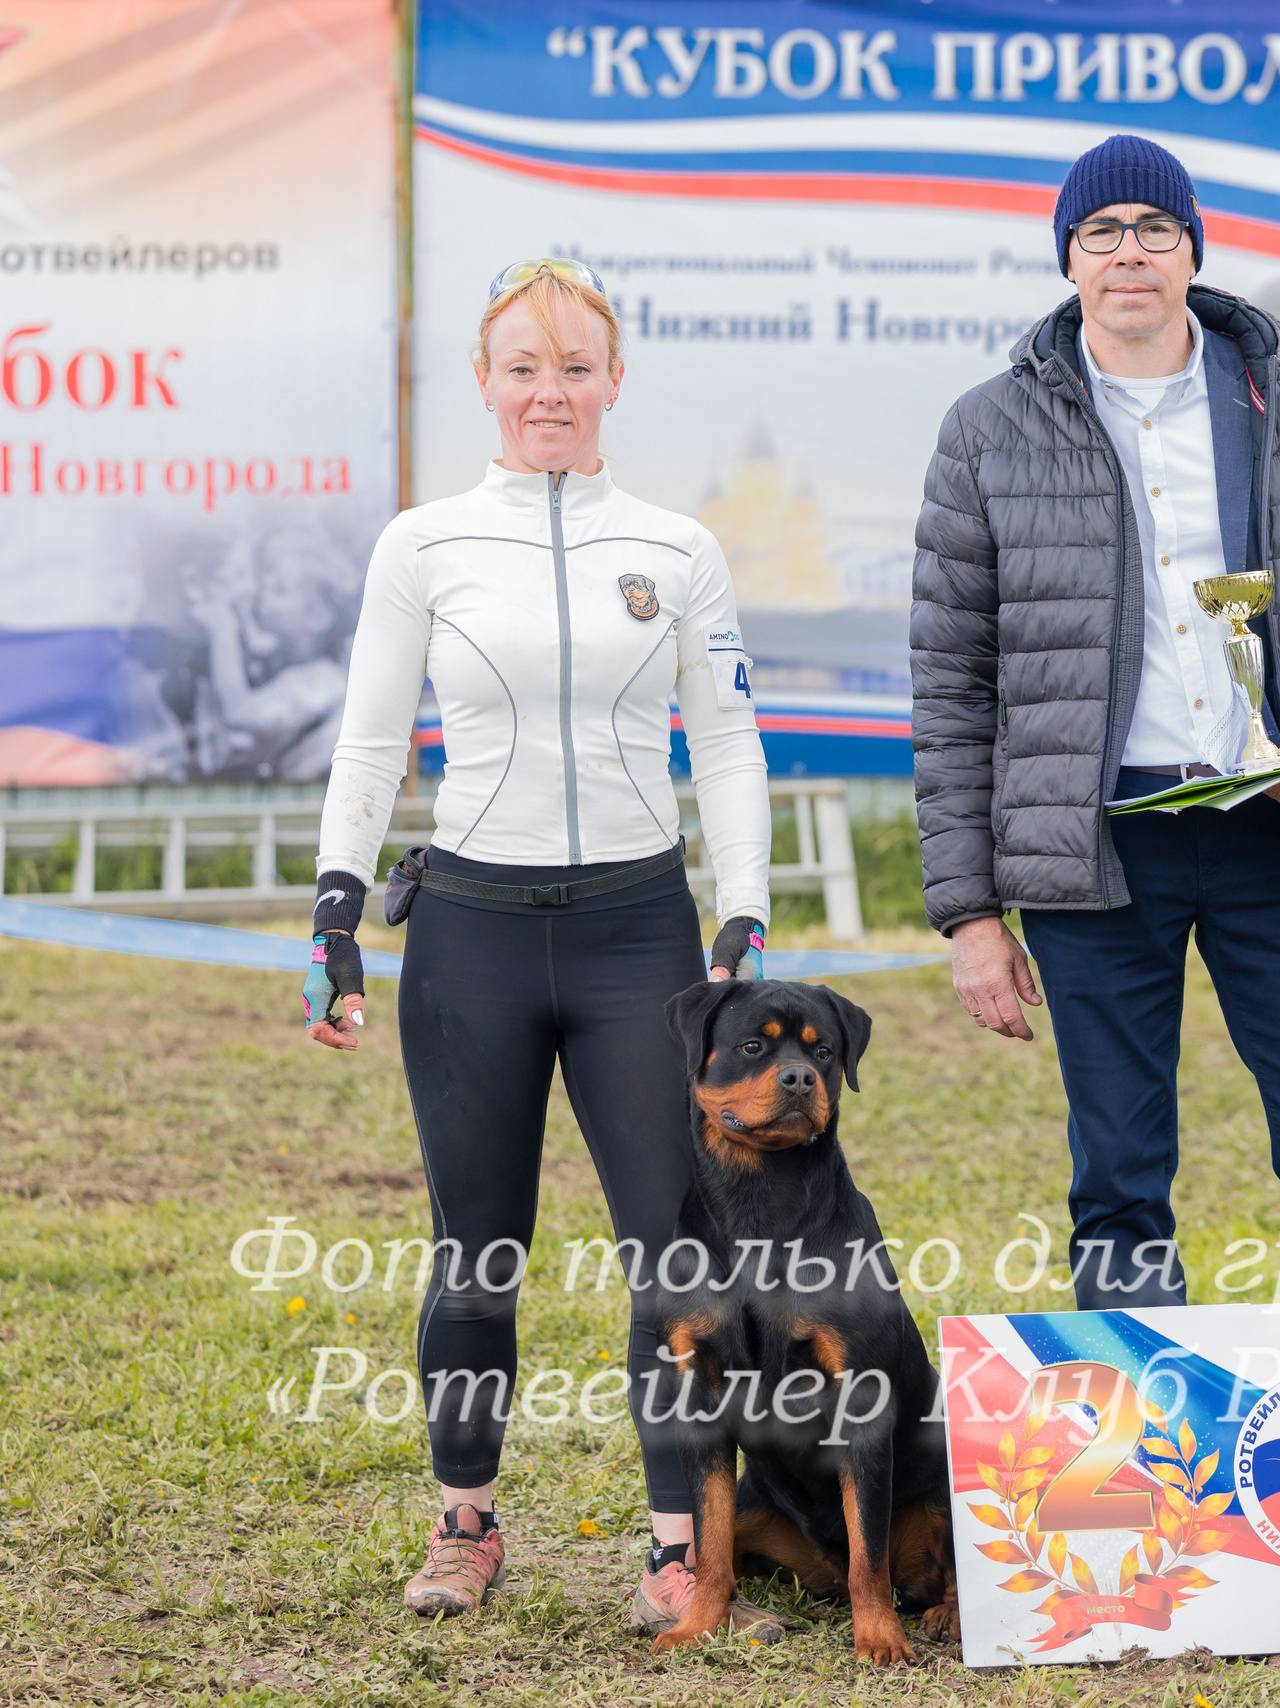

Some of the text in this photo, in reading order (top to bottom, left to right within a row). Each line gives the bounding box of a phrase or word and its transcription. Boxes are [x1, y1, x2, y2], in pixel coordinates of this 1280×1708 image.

[546, 25, 899, 101] “КУБОК
[2, 321, 183, 412] бок
[0, 444, 353, 512] Новгорода
[734, 662, 751, 699] 4
[1030, 1360, 1156, 1533] 2
